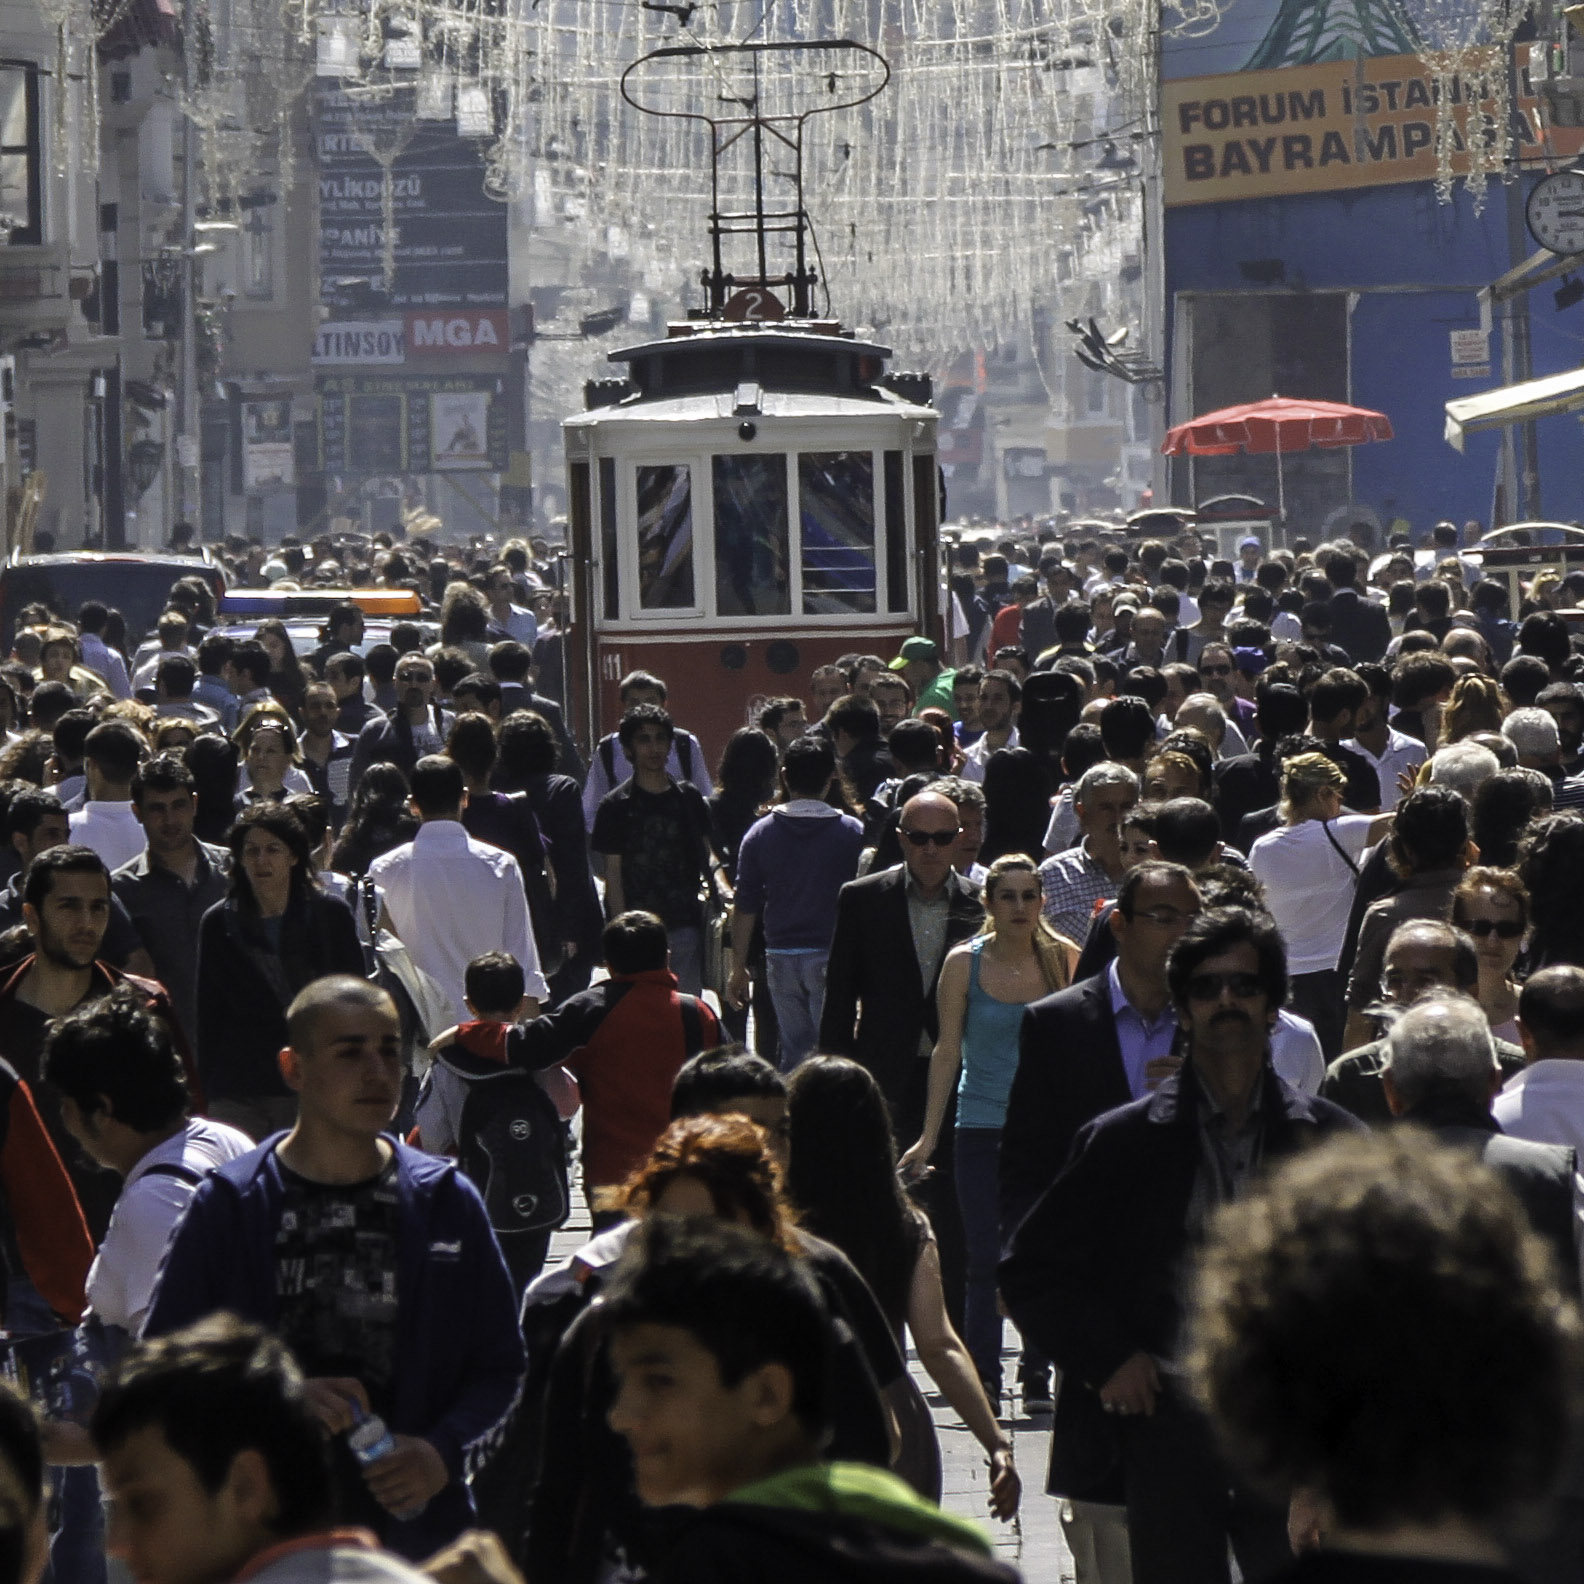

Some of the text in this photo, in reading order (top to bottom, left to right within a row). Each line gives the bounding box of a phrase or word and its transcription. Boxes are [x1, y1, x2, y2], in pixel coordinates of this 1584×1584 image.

[1178, 87, 1327, 135] FORUM
[745, 292, 763, 319] 2
[414, 318, 498, 347] MGA
